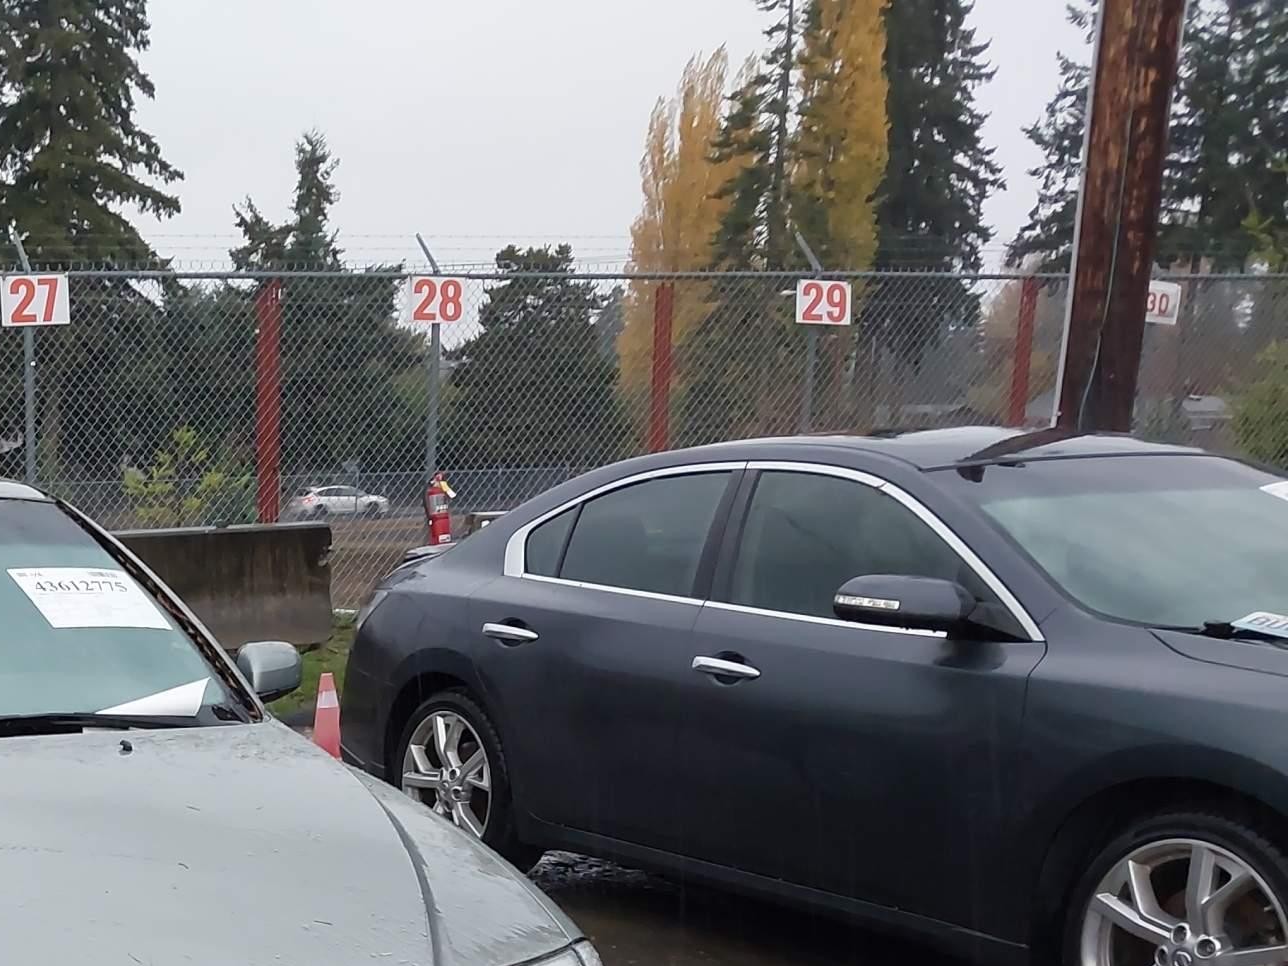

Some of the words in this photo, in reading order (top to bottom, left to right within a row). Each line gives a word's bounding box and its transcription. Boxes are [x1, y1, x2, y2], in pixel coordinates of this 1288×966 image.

[10, 277, 58, 322] 27
[413, 278, 462, 322] 28
[802, 282, 847, 323] 29
[35, 579, 128, 592] 43612775
